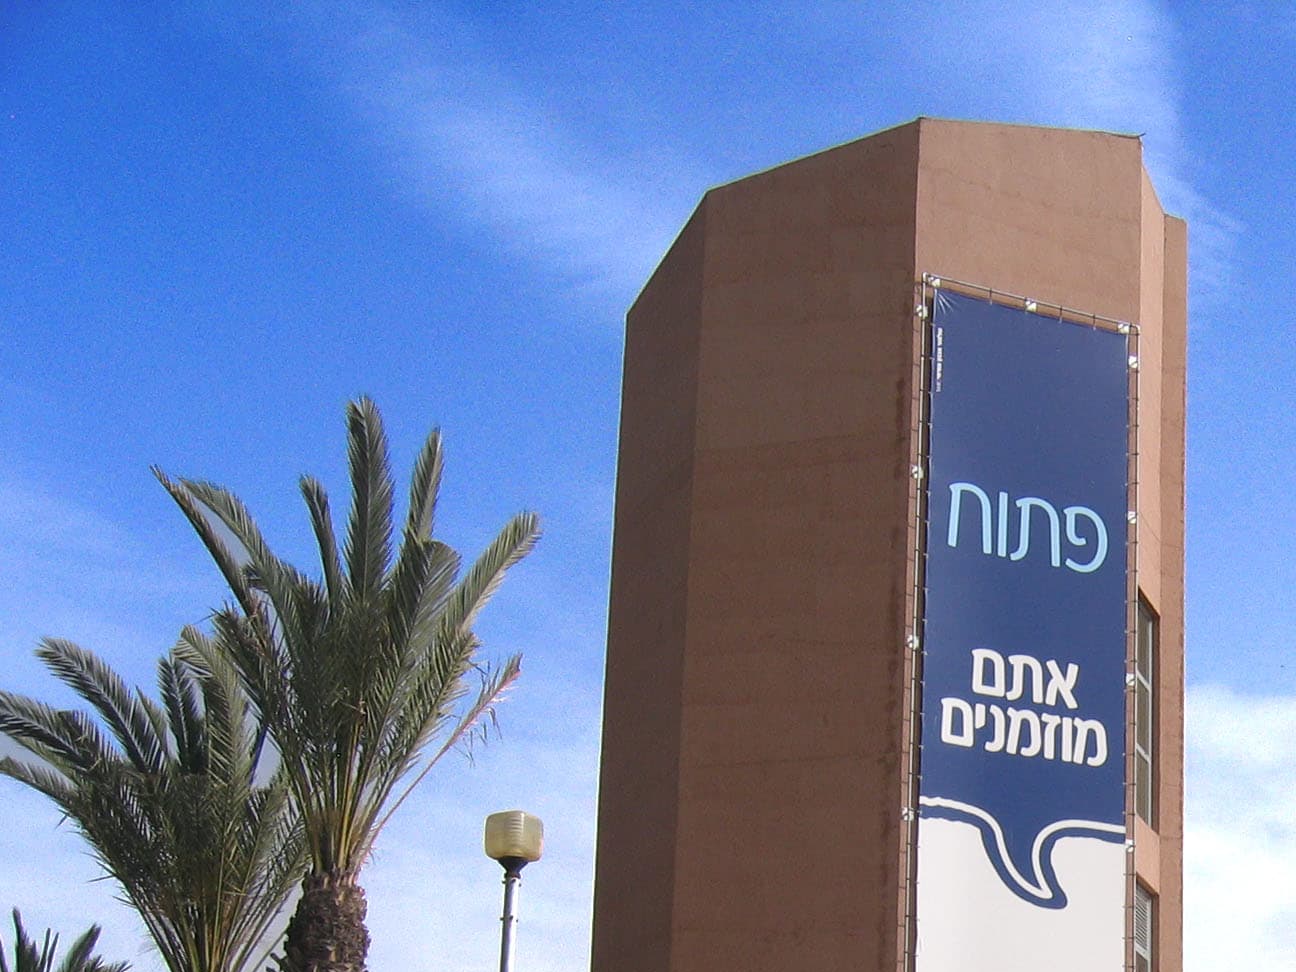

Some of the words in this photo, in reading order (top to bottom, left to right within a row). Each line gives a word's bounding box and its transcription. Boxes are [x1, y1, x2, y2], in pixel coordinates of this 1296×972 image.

[947, 482, 1109, 573] פתוח
[970, 648, 1080, 710] אתם
[940, 697, 1108, 767] מוזמנים
